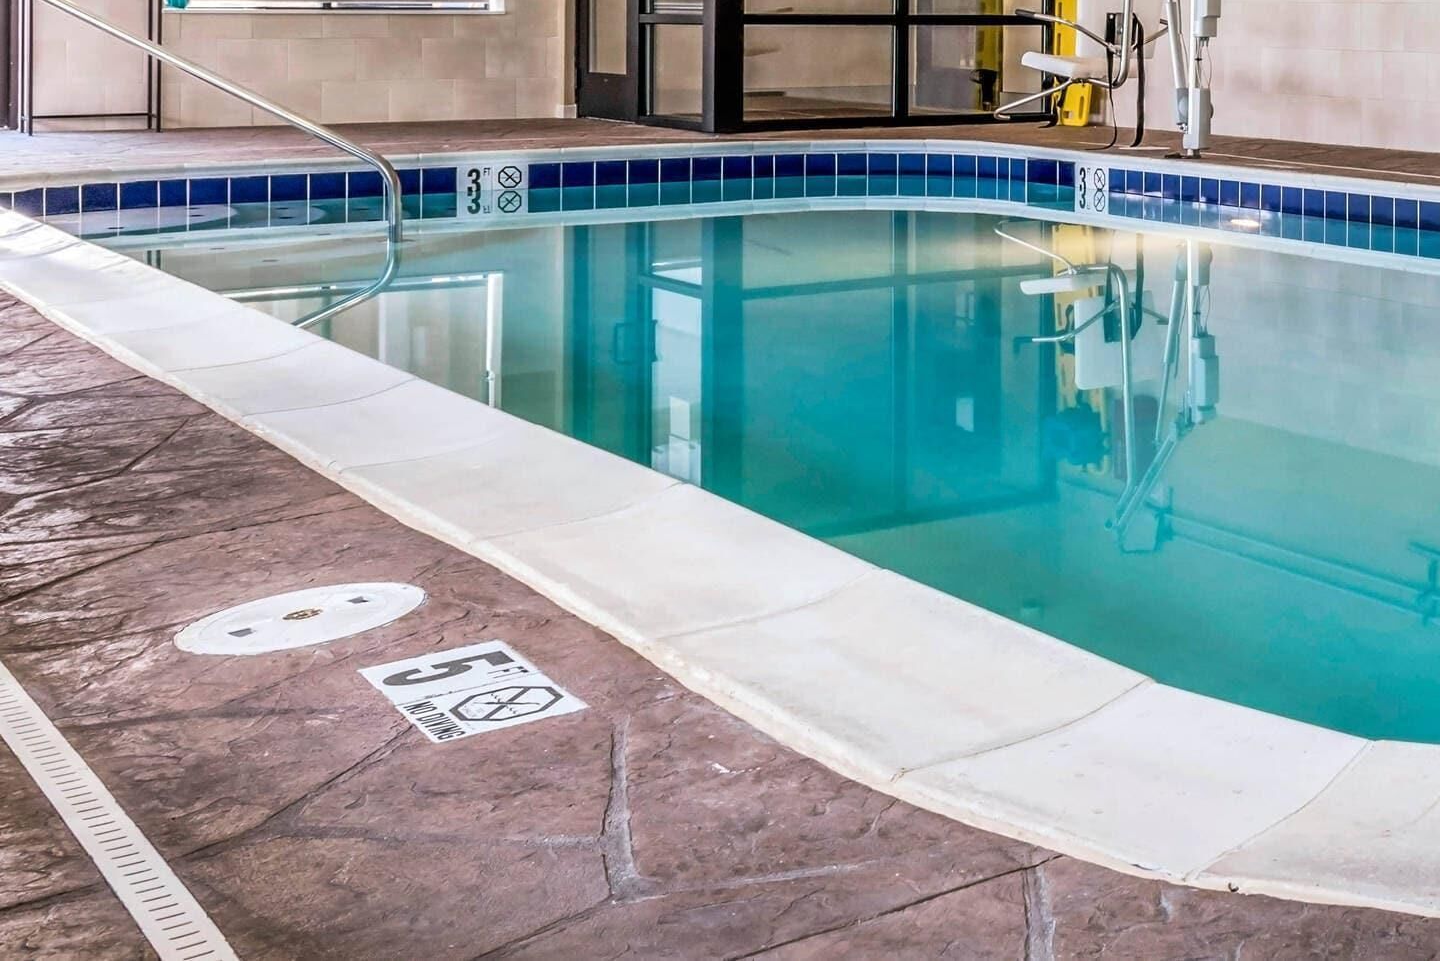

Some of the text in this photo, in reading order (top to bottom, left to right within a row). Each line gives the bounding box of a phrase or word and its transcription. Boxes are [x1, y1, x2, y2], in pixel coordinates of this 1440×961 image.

[467, 169, 481, 192] 3
[1080, 167, 1086, 189] 3
[382, 650, 515, 686] 5
[403, 701, 466, 739] NO DIVING
